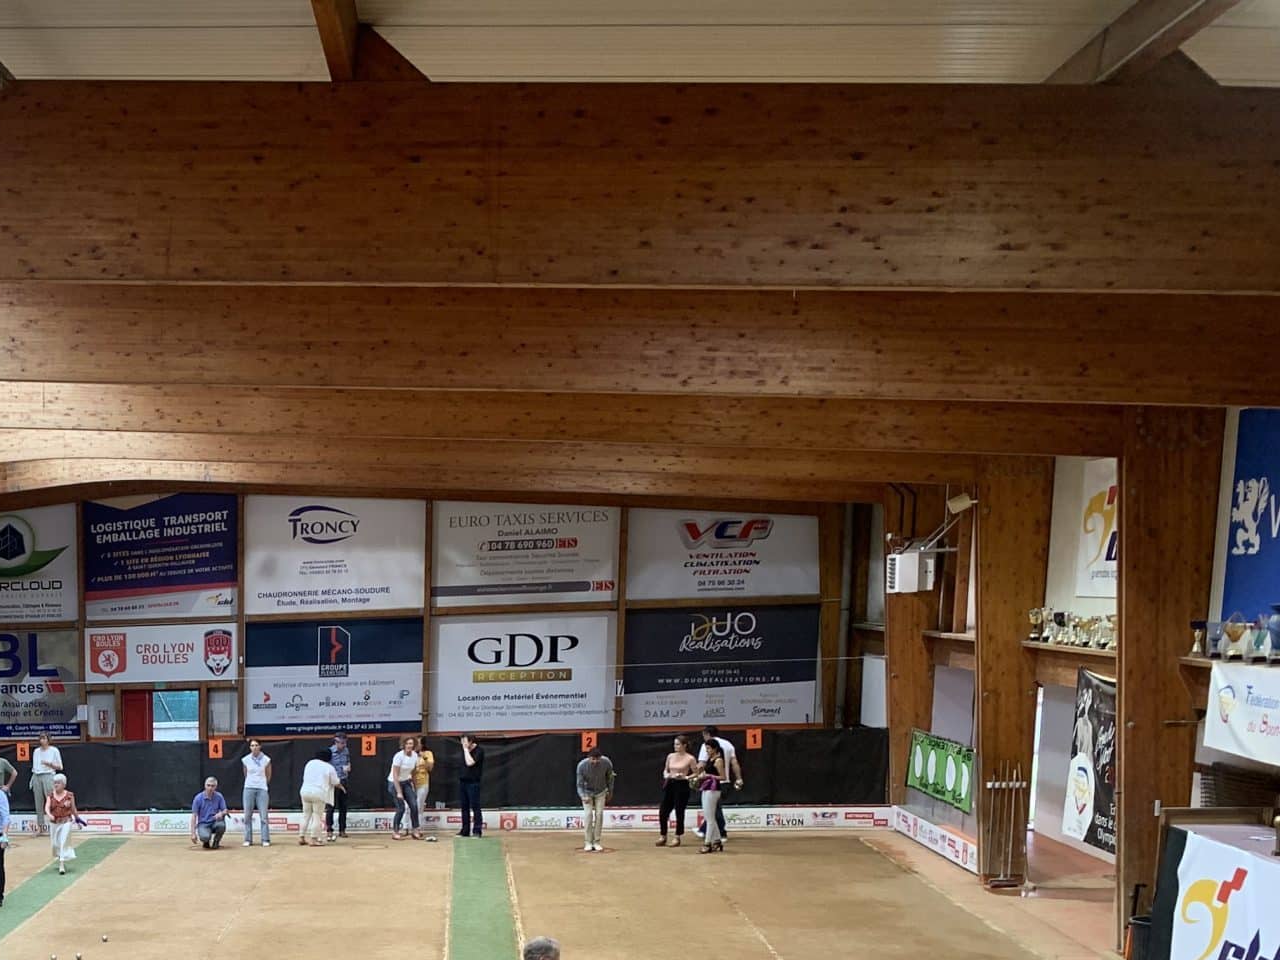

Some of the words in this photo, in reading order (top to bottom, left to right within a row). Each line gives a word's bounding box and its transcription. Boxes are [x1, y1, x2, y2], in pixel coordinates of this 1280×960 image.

[91, 518, 156, 534] LOGISTIQUE
[163, 510, 229, 526] TRANSPORT
[449, 515, 491, 529] EURO
[494, 513, 536, 527] TAXIS
[537, 510, 609, 526] SERVICES
[96, 528, 161, 544] EMBALLAGE
[163, 522, 228, 538] INDUSTRIEL
[287, 518, 360, 540] TRONCY
[497, 529, 522, 537] Daniel
[491, 541, 502, 550] 04
[504, 541, 515, 549] 78
[517, 540, 534, 549] 690
[689, 551, 757, 560] VENTILATION
[257, 590, 319, 600] CHAUDRONNERIE
[687, 612, 757, 640] DUO
[135, 643, 160, 655] CRO
[163, 642, 195, 654] LYON
[679, 633, 764, 652] Realisations
[467, 633, 580, 668] GDP
[141, 653, 189, 665] BOULES
[320, 664, 348, 672] GROUPE
[457, 694, 491, 703] Location
[491, 694, 502, 702] de
[503, 692, 534, 701] Matériel
[2, 699, 50, 709] Assurances,
[364, 740, 373, 752] 3
[586, 736, 593, 747] 2
[19, 746, 27, 759] 5
[212, 743, 220, 756] 4
[781, 818, 804, 826] LYON
[1094, 811, 1108, 827] dans
